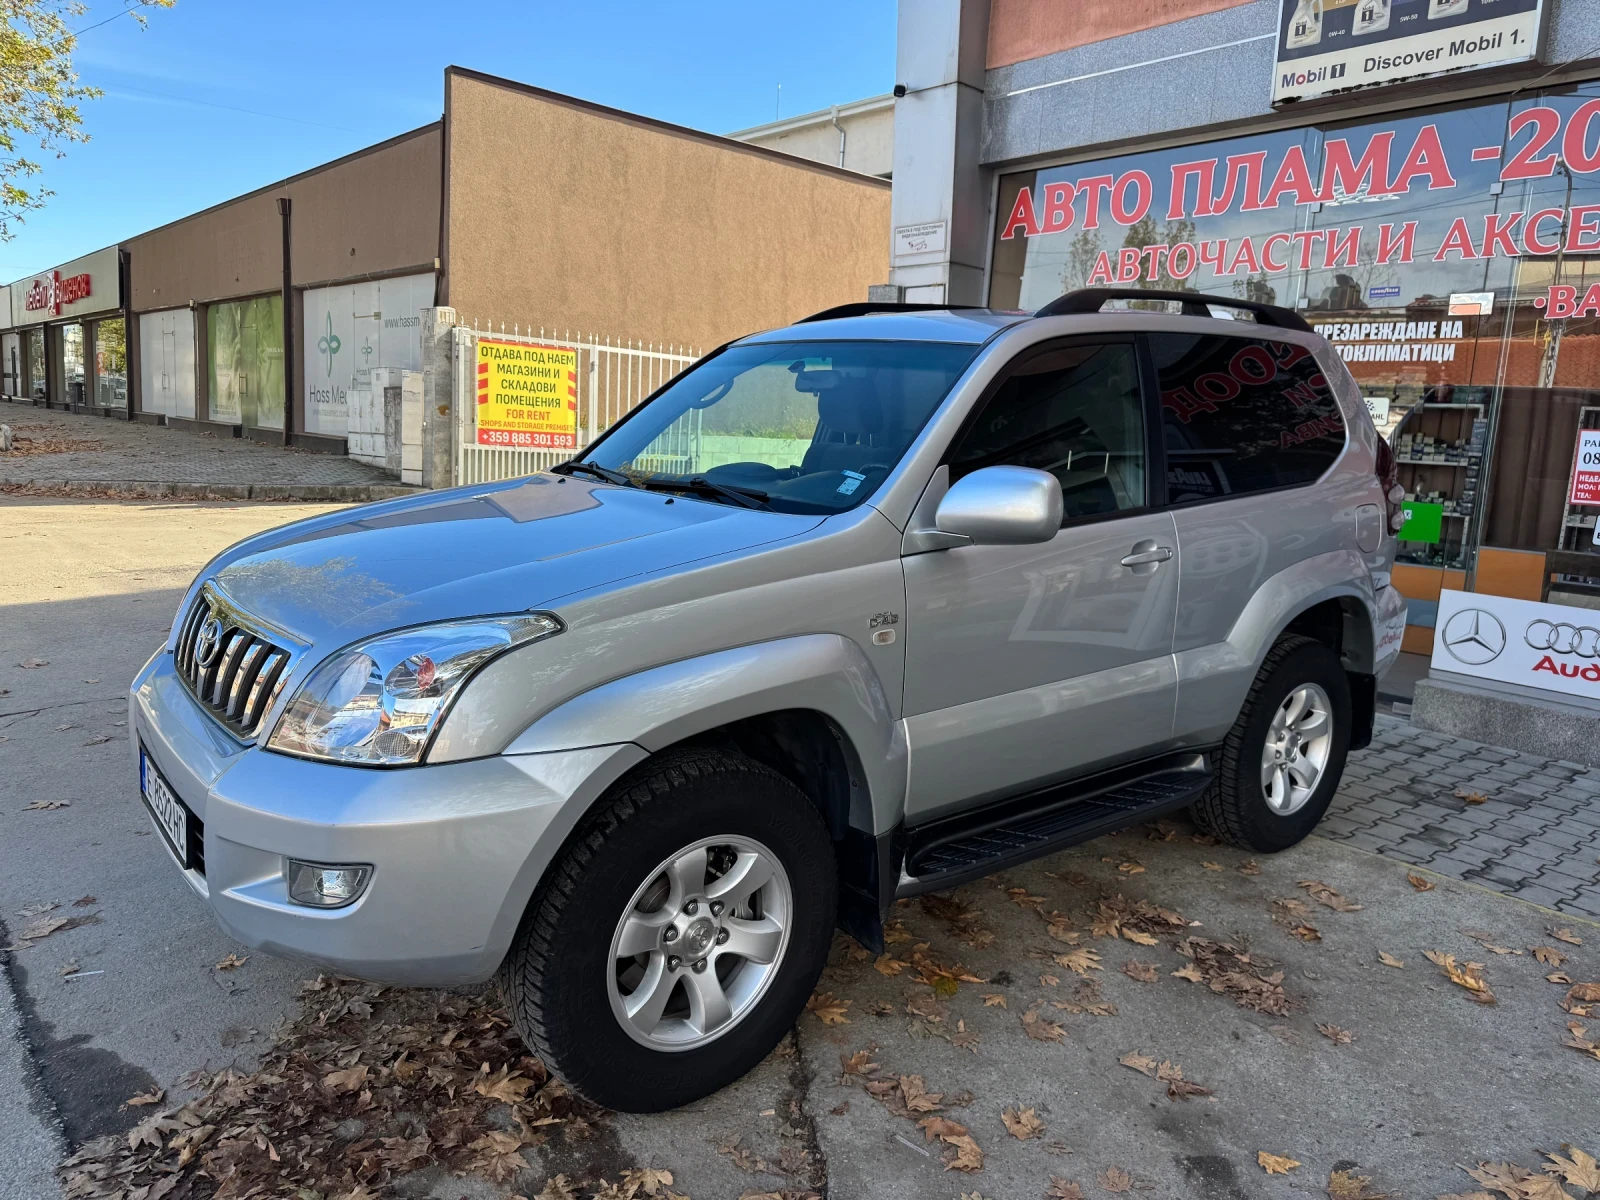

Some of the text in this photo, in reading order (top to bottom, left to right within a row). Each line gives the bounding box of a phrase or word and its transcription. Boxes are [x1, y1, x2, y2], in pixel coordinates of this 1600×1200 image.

[1400, 14, 1418, 22] 5W-50
[1281, 67, 1326, 88] Mobil
[1363, 47, 1444, 73] Discover
[1449, 32, 1502, 56] Mobil
[1509, 29, 1526, 45] 1.
[1000, 169, 1153, 240] АВТО
[1166, 124, 1458, 221] ПЛАМА
[1086, 204, 1600, 286] АВТОЧАСТИ И АКСЕ
[384, 315, 420, 328] www.hassm
[1440, 321, 1463, 338] НА
[481, 346, 574, 366] ОТДАВА ПОД НАЕМ
[1334, 343, 1455, 363] ТОКЛИМАТИЦИ
[497, 363, 560, 379] МАГАЗИНИ И
[501, 379, 556, 393] СКЛАДОВИ
[309, 385, 330, 404] Hass
[496, 393, 561, 408] ПОМЕЩЕНИЯ
[506, 409, 551, 421] FOR RENT
[480, 420, 502, 428] SHOPS
[517, 422, 545, 430] STORAGE
[482, 431, 573, 446] +359 885 301 593
